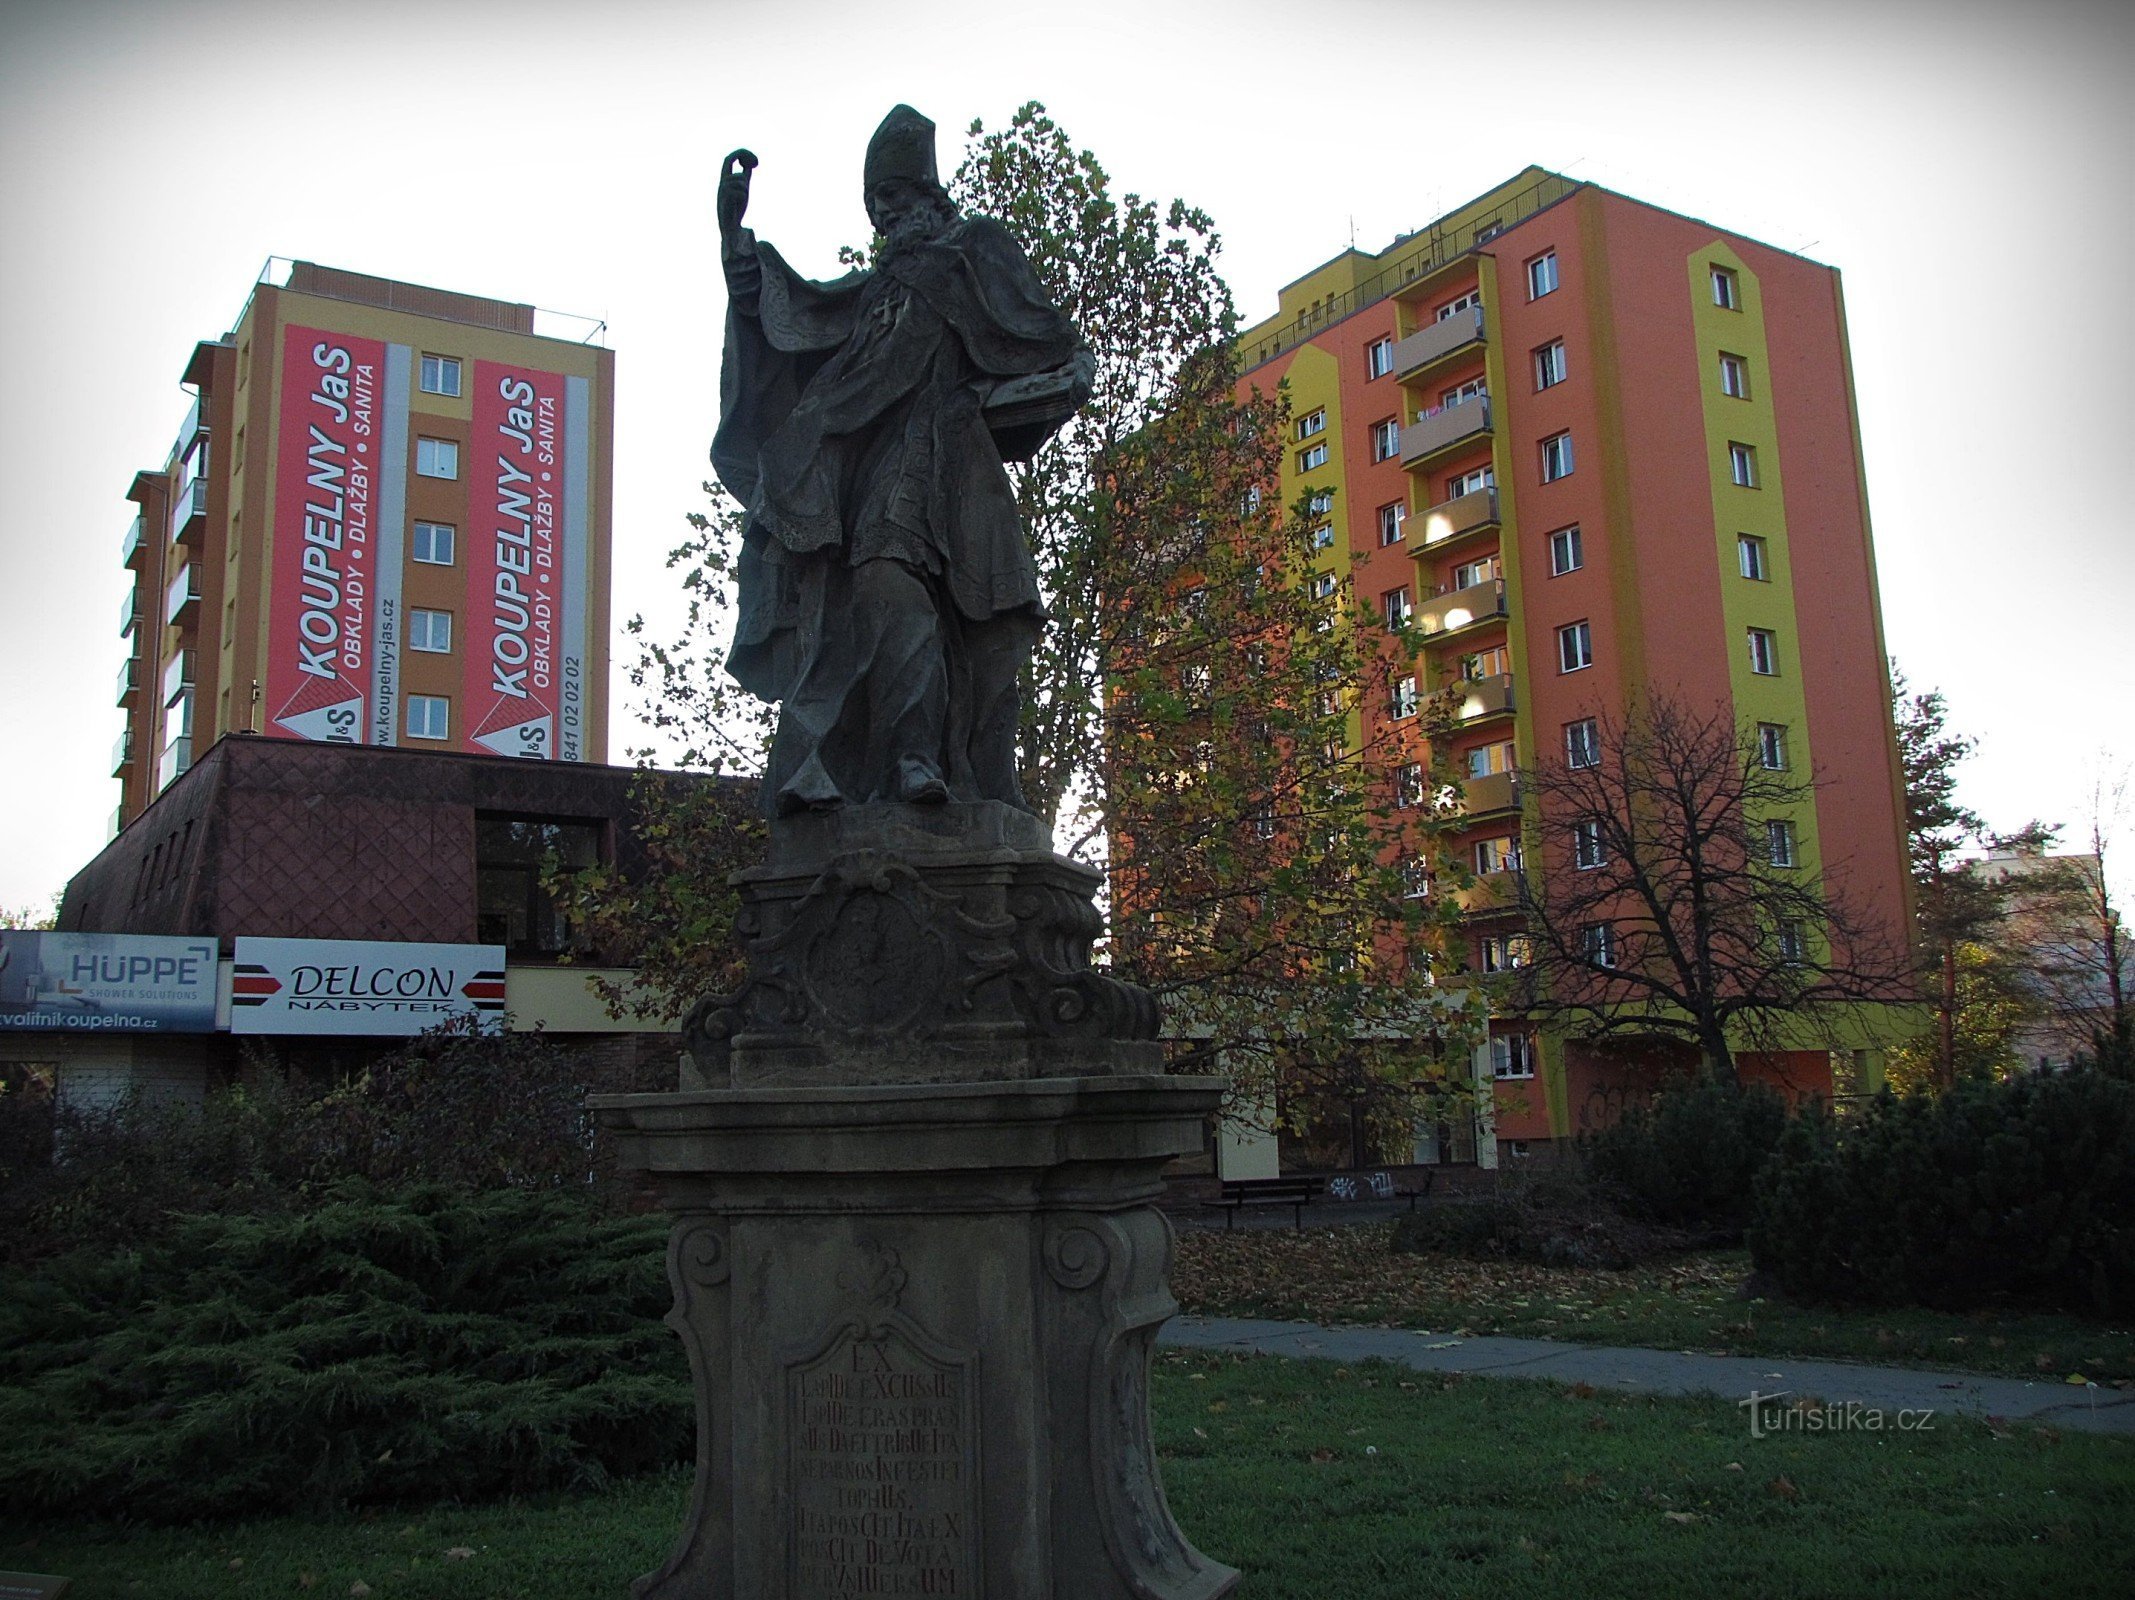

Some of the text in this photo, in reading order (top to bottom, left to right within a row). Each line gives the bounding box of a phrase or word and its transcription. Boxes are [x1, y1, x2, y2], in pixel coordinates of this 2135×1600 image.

[298, 342, 354, 680] KOUPELNY JaS
[342, 364, 374, 669] OBKLADY DLAŽBY SANITA
[492, 376, 536, 699] KOUPELNY JaS
[533, 397, 556, 689] OBKLADY DLAŽBY SANITA
[377, 598, 394, 746] w.koupelny-jas.cz
[566, 657, 579, 678] 02
[565, 681, 579, 702] 02
[564, 706, 578, 727] 02
[72, 954, 198, 985] HÜPPE
[290, 965, 455, 998] DELCON
[89, 988, 198, 1000] SHOWER SOLUTIONS
[288, 1000, 452, 1012] NÁBYTEK
[0, 1012, 158, 1029] valitnikoupelna.cz
[852, 1344, 893, 1372] EX
